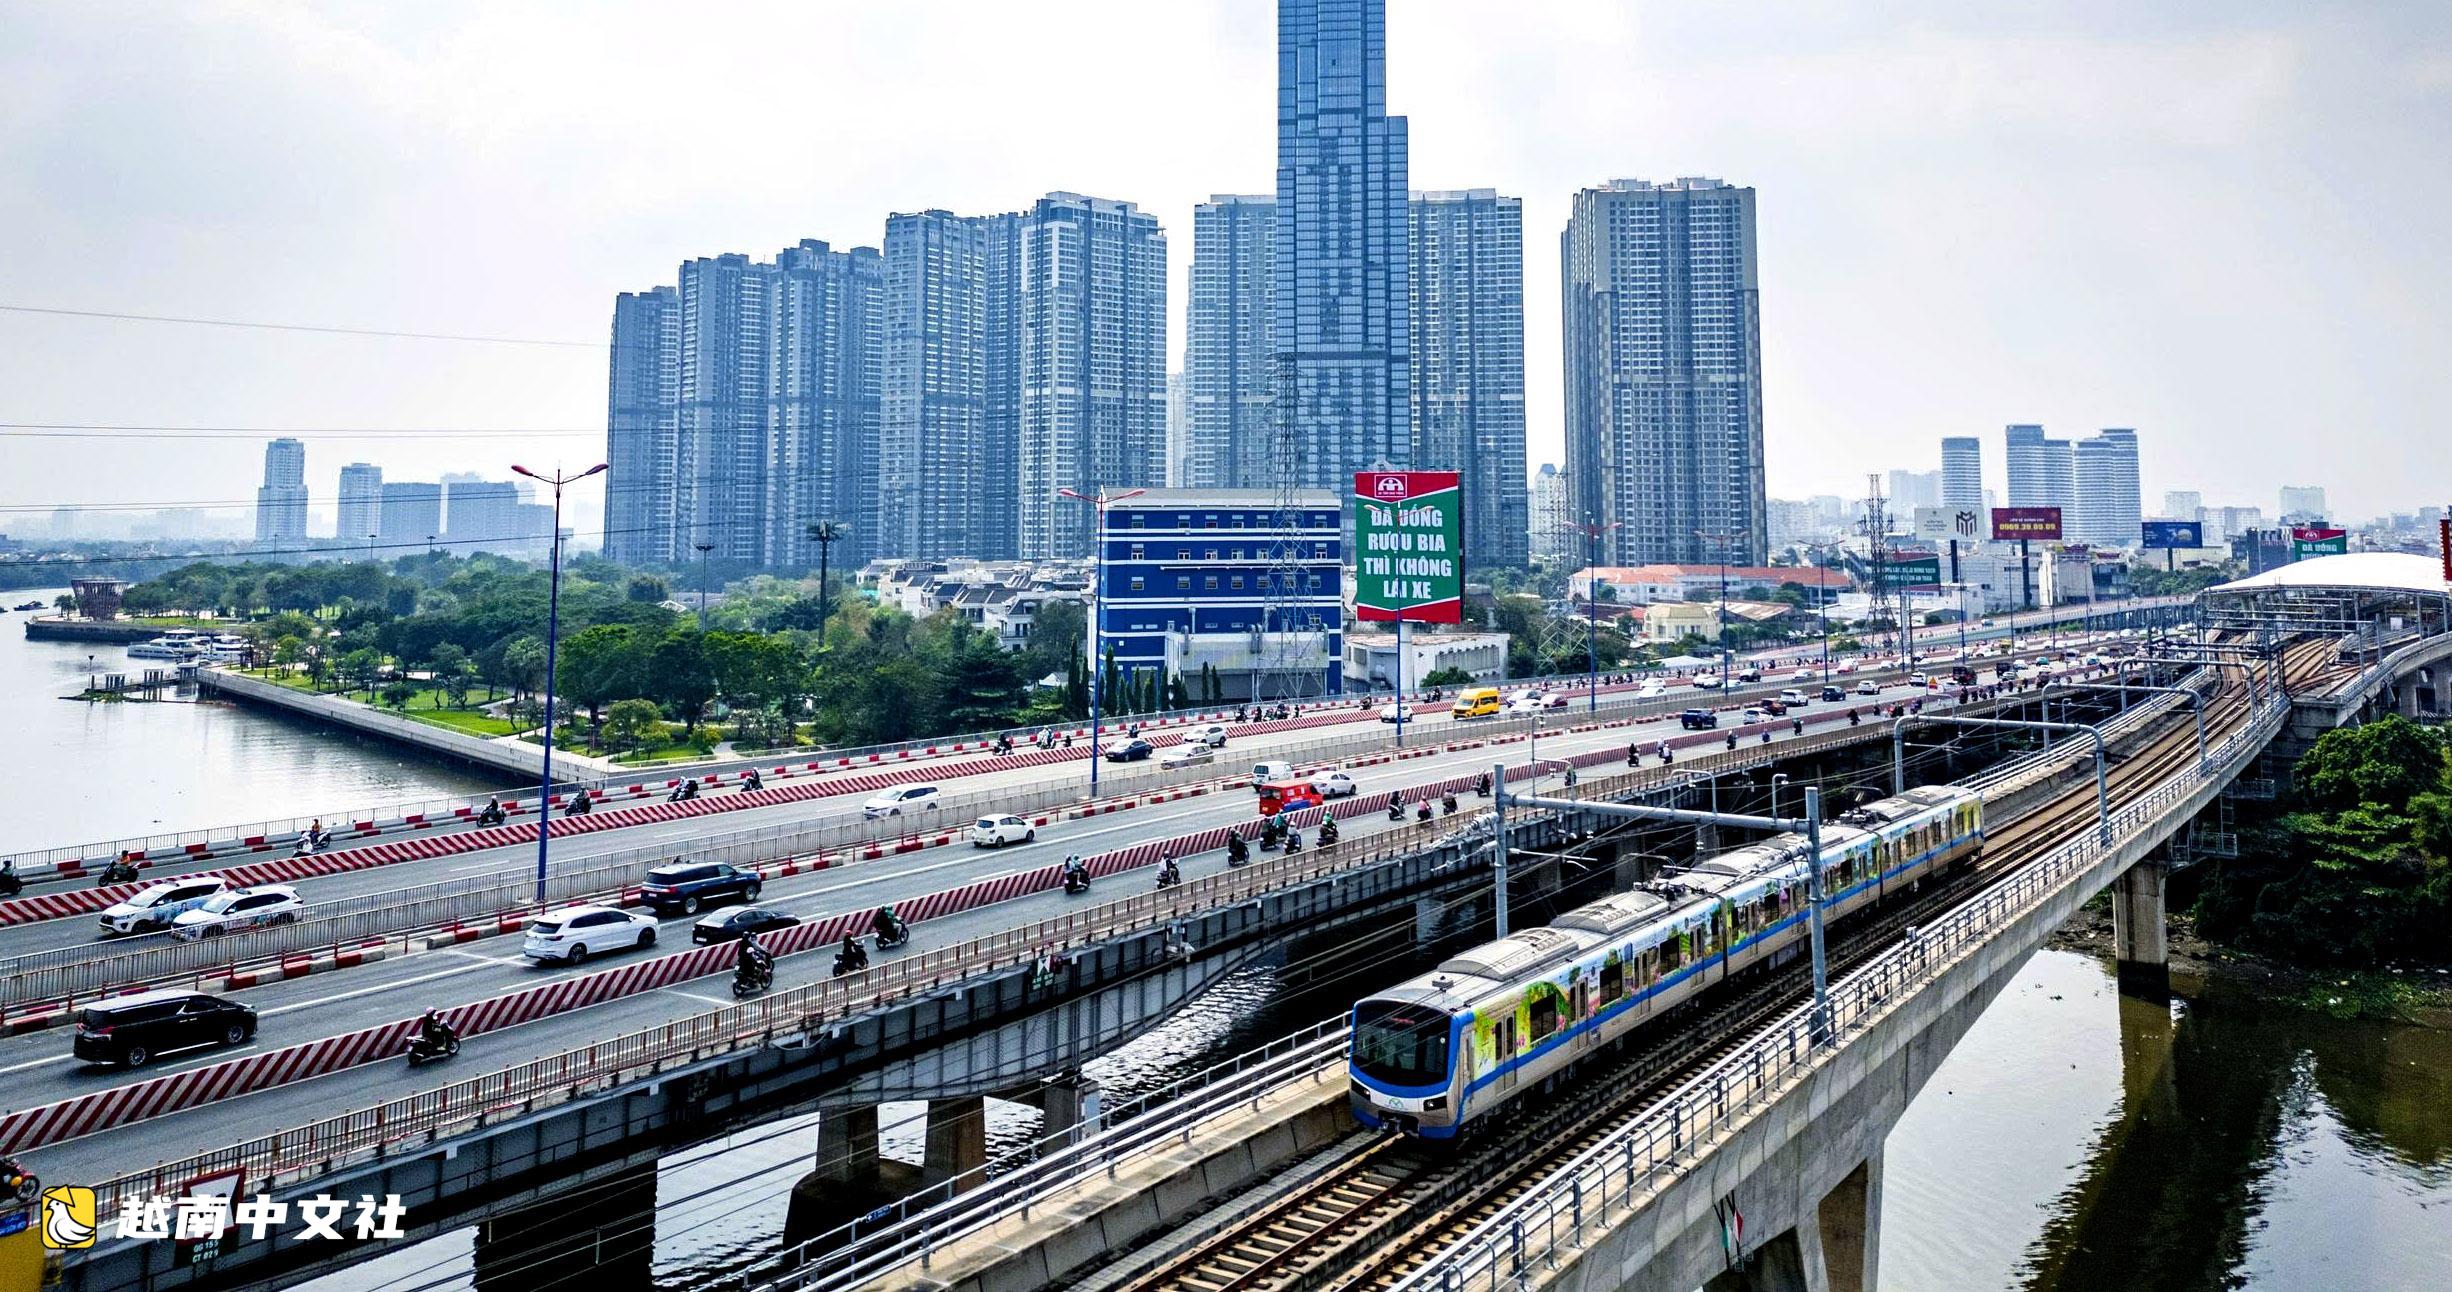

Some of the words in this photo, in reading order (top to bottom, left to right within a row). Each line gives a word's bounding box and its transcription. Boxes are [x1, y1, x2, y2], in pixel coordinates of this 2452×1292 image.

[1371, 506, 1393, 526] ĐÃ
[1398, 504, 1443, 527] UỐNG
[1368, 531, 1412, 554] RƯỢU
[1417, 534, 1446, 552] BIA
[1364, 556, 1390, 575] THÌ
[1395, 556, 1452, 577] KHÔNG
[1383, 578, 1407, 598] LÁI
[1412, 581, 1432, 599] XE
